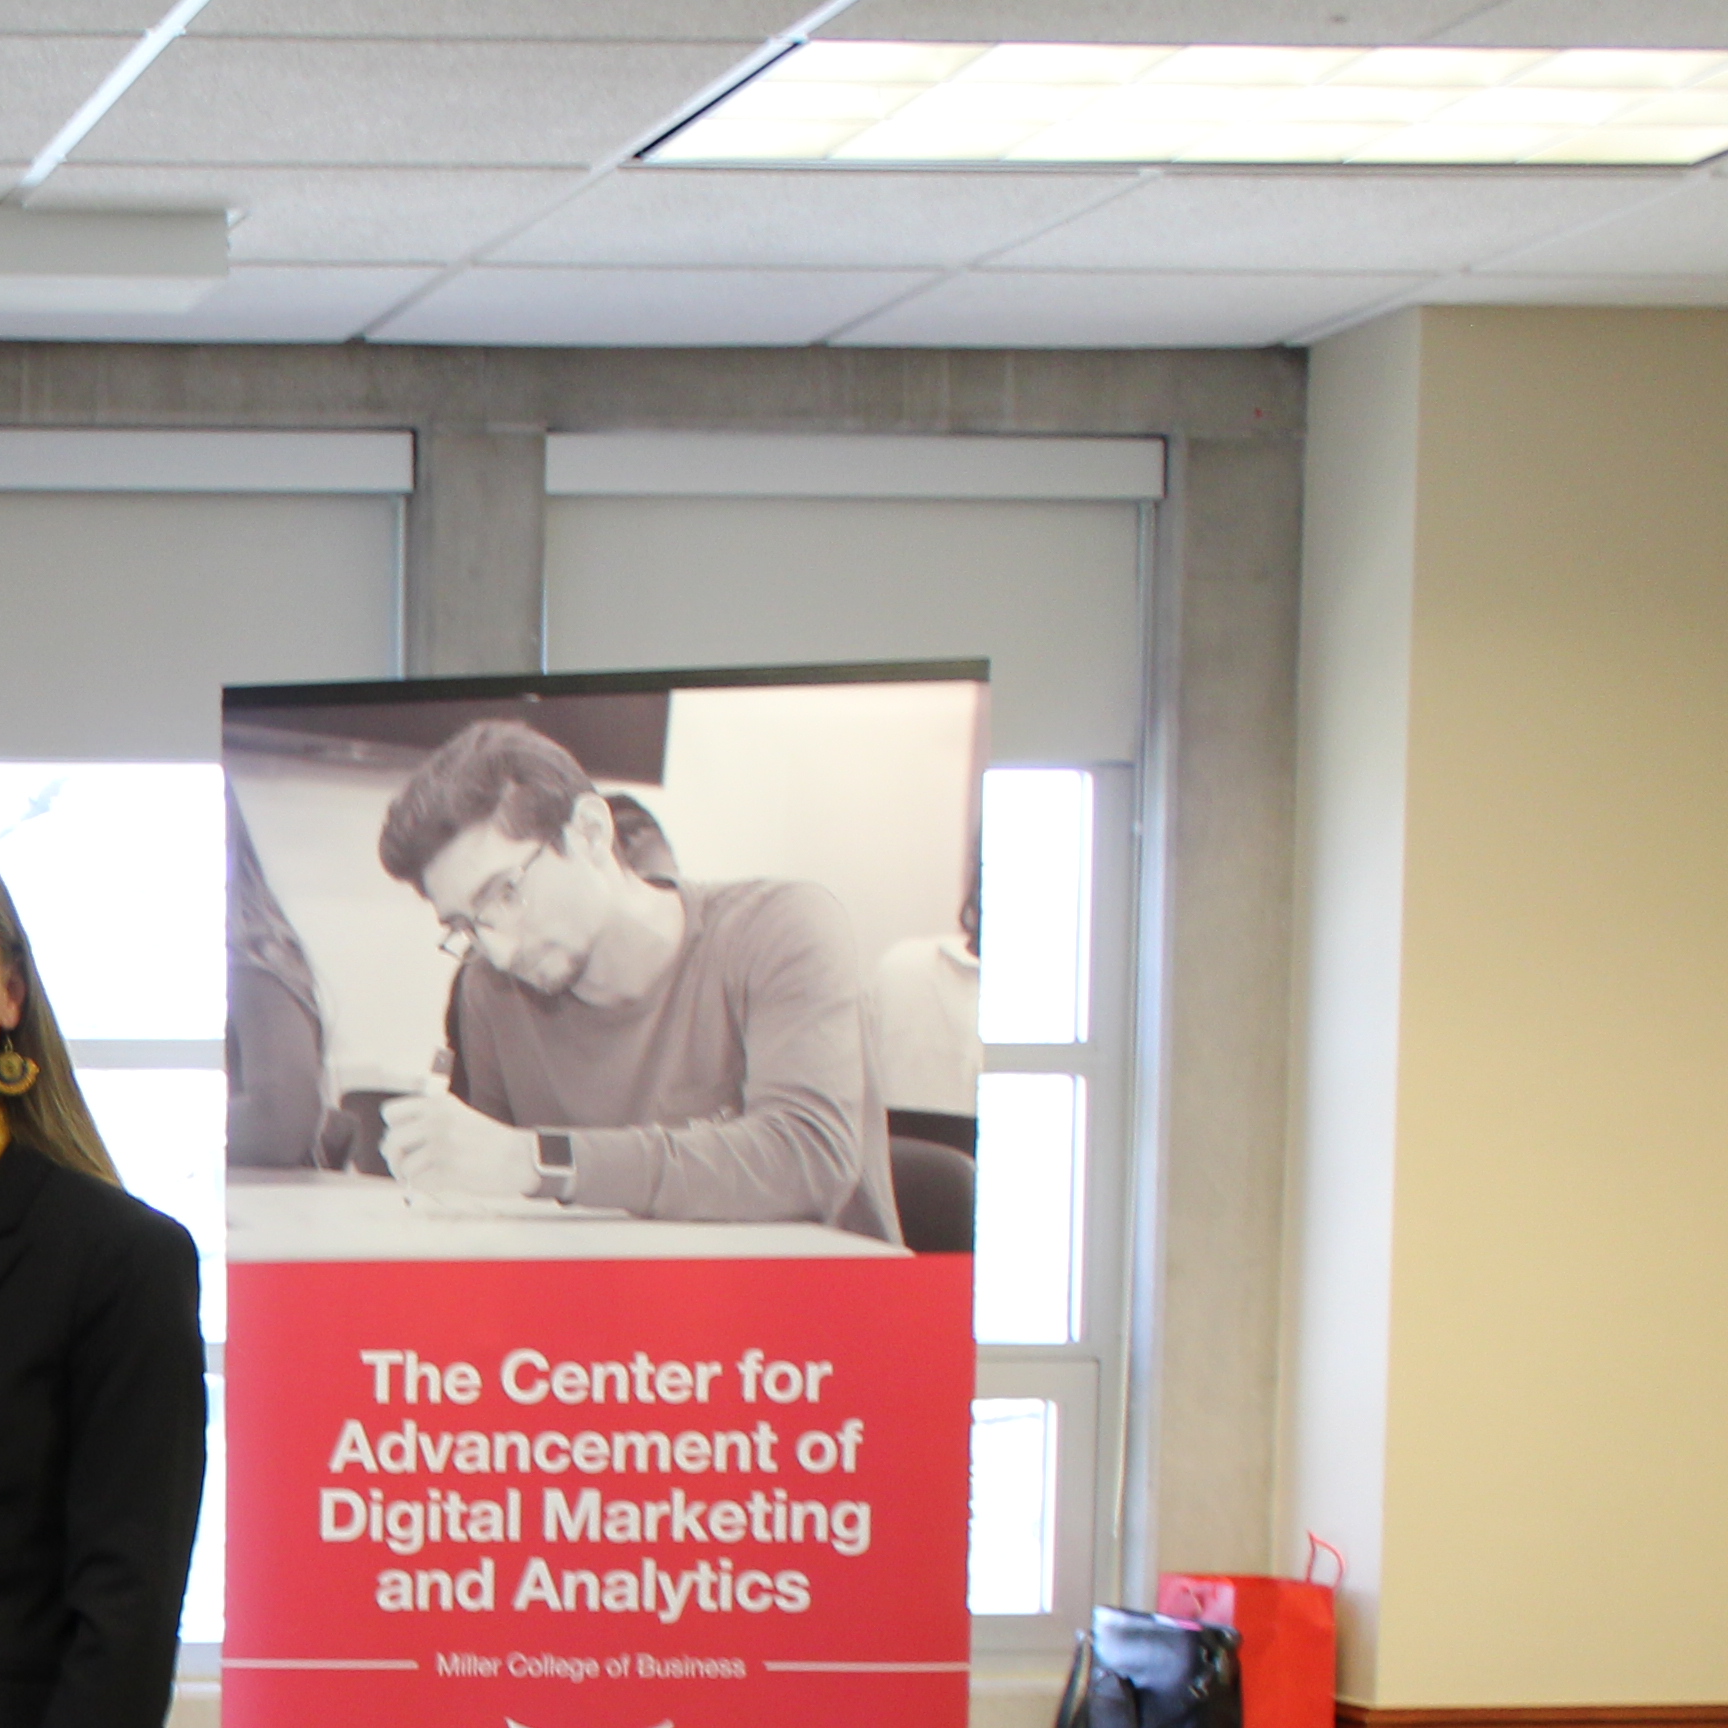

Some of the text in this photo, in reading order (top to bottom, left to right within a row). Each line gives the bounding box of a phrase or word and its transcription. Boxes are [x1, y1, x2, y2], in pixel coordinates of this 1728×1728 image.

[360, 1348, 833, 1404] The Center for
[329, 1418, 864, 1474] Advancement of
[320, 1488, 871, 1556] Digital Marketing
[376, 1557, 811, 1624] and Analytics
[436, 1651, 747, 1684] Miller College of Business
